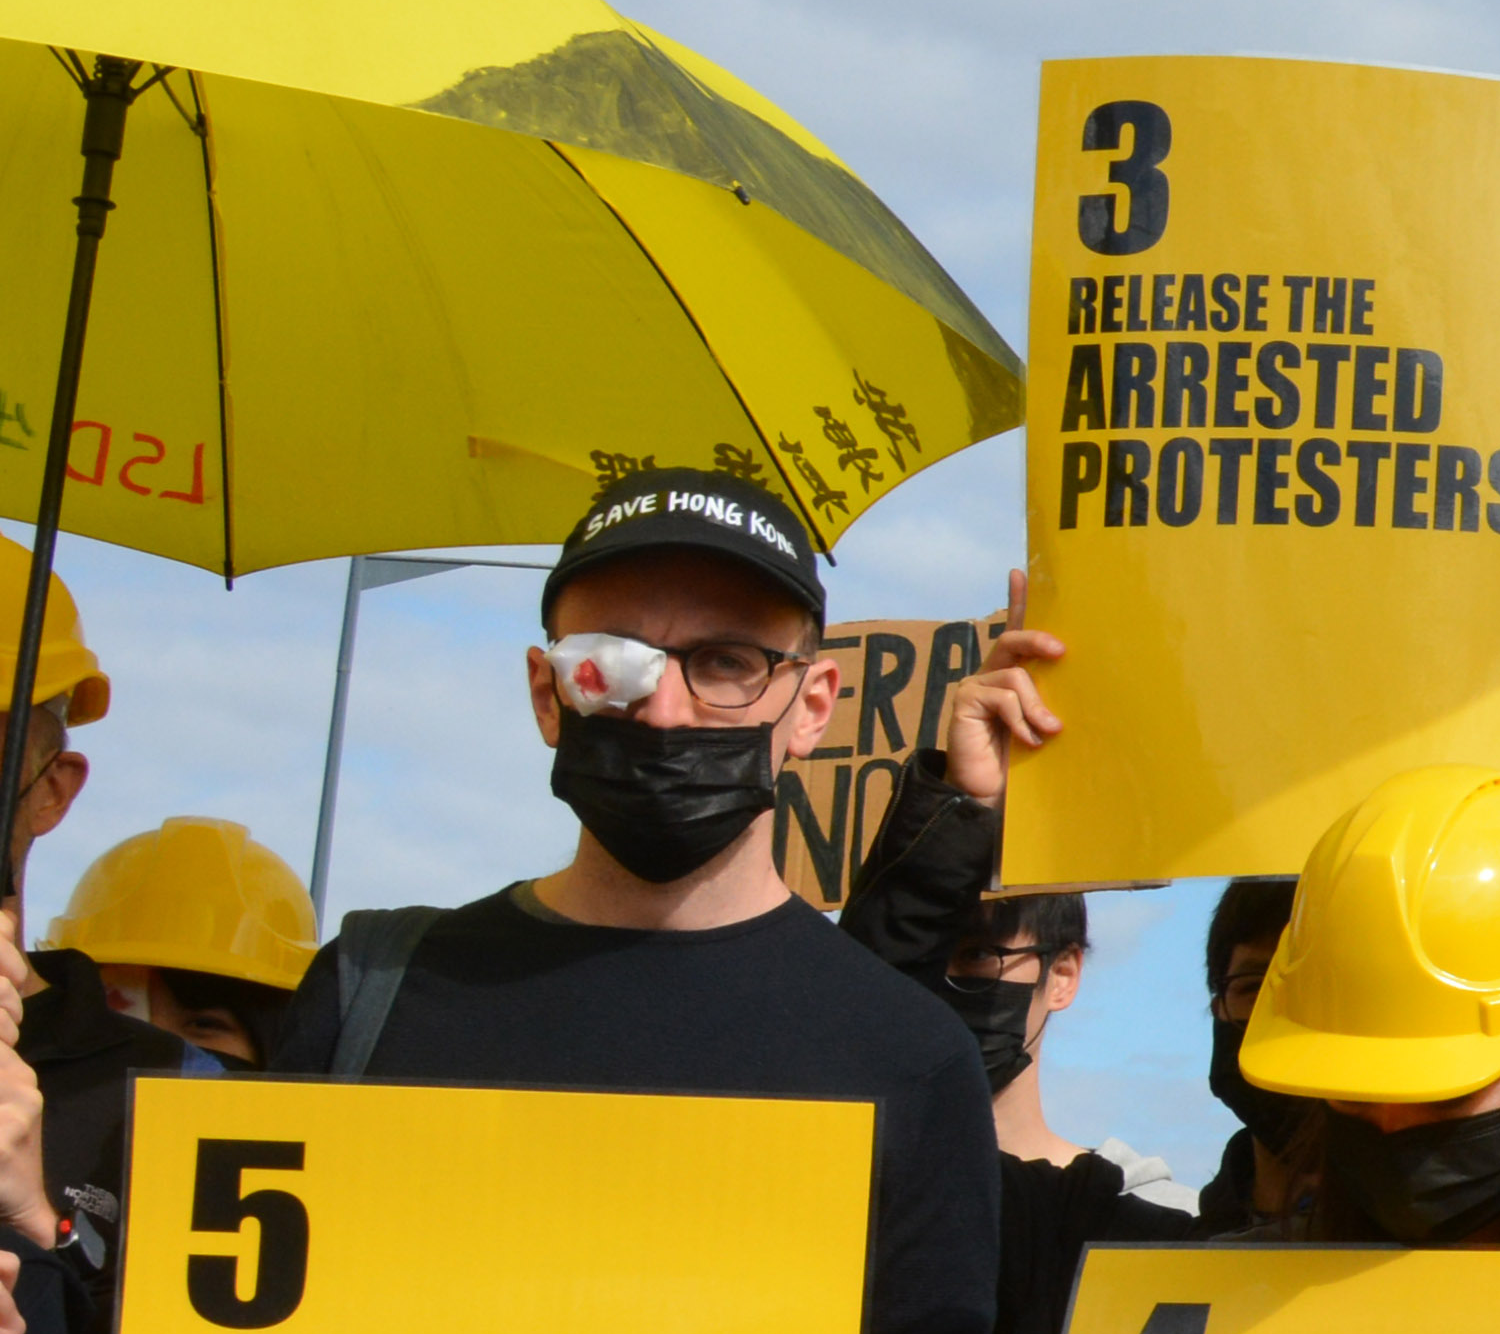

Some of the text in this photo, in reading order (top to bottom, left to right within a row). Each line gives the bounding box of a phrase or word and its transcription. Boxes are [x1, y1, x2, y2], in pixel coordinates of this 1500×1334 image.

[1077, 100, 1172, 256] 3
[1067, 273, 1376, 336] RELEASE THE
[1060, 342, 1444, 434] ARRESTED
[583, 493, 657, 542] SAVE
[668, 491, 742, 527] HONG
[186, 1137, 310, 1330] 5
